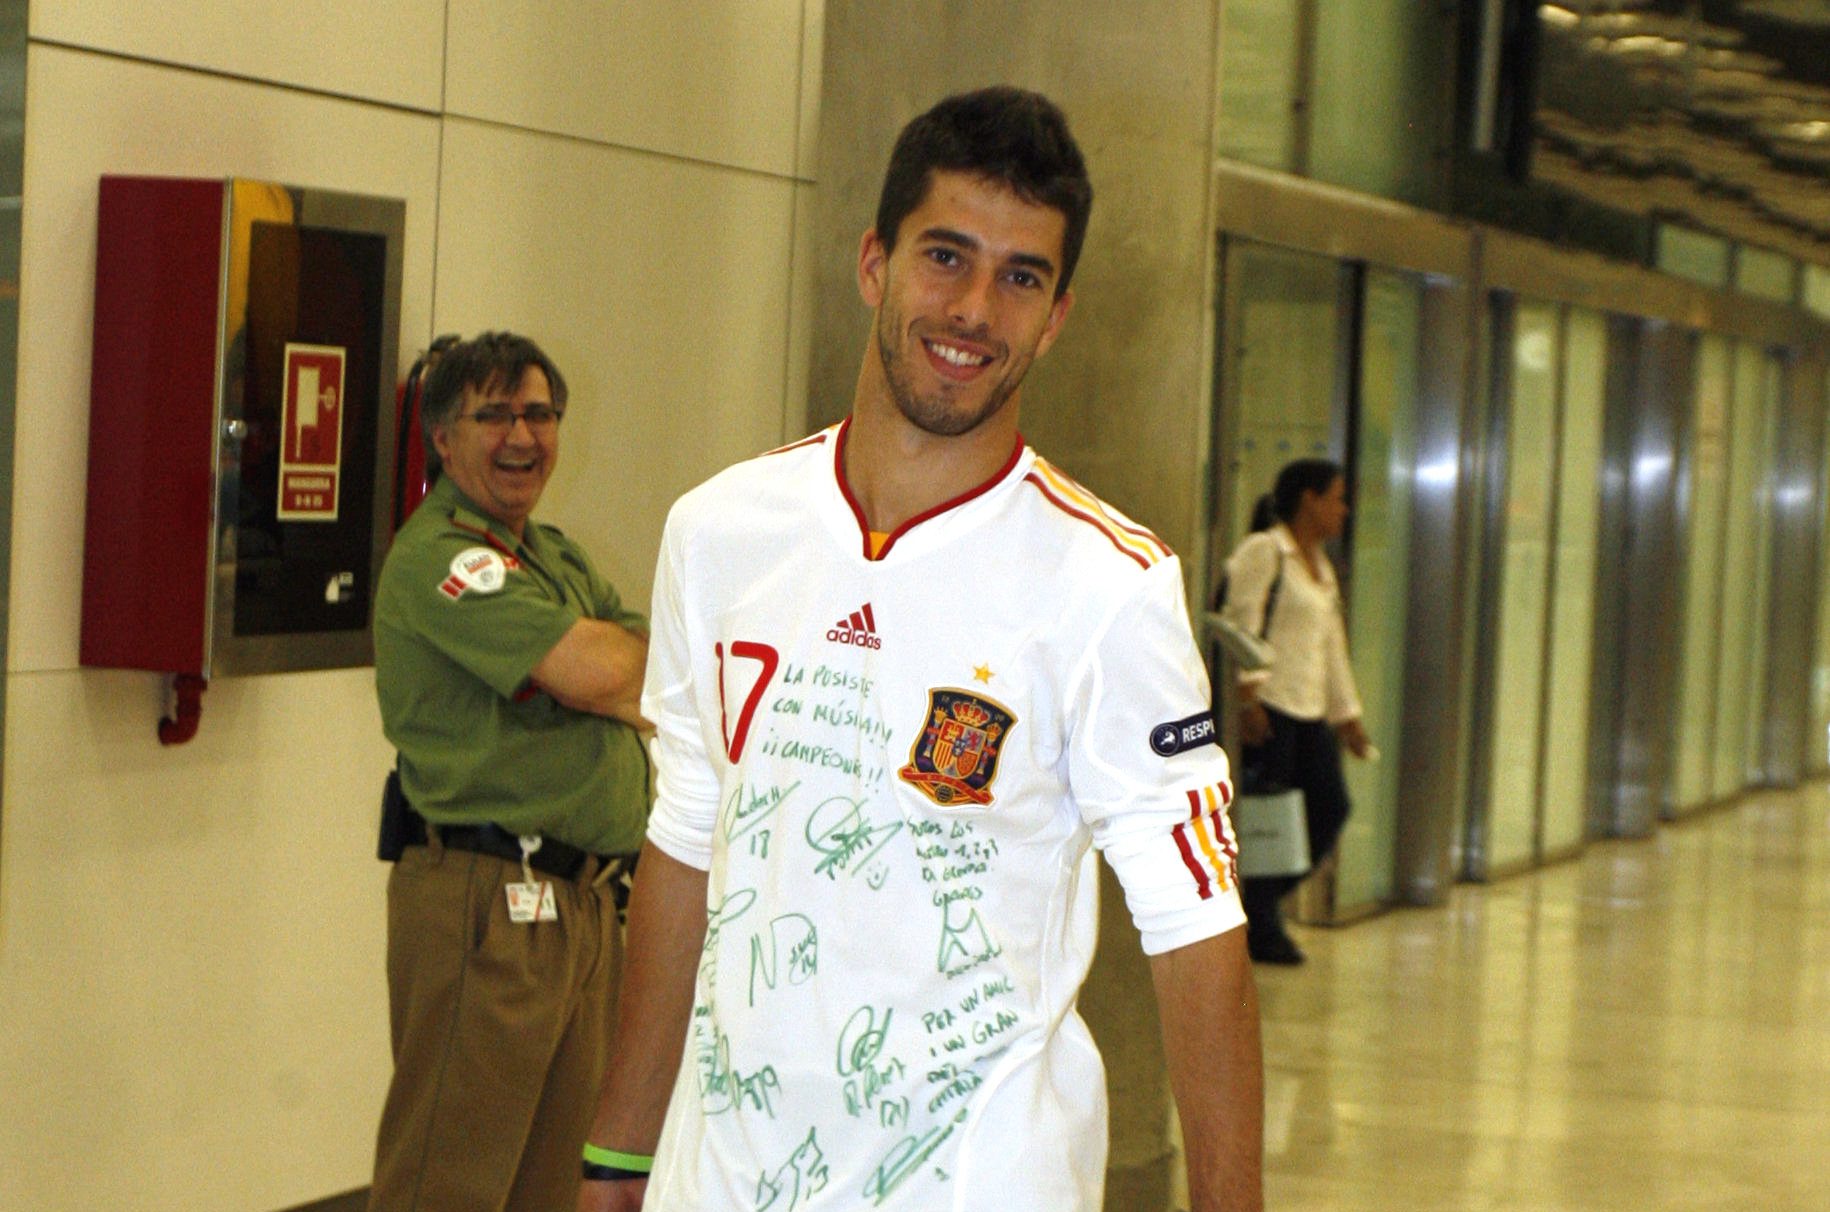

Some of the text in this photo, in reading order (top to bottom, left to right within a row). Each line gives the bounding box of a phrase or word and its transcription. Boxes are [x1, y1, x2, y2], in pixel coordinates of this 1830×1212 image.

[826, 628, 881, 650] adidas
[783, 663, 805, 685] LA
[772, 697, 802, 714] CON
[972, 1009, 1019, 1044] GRAN
